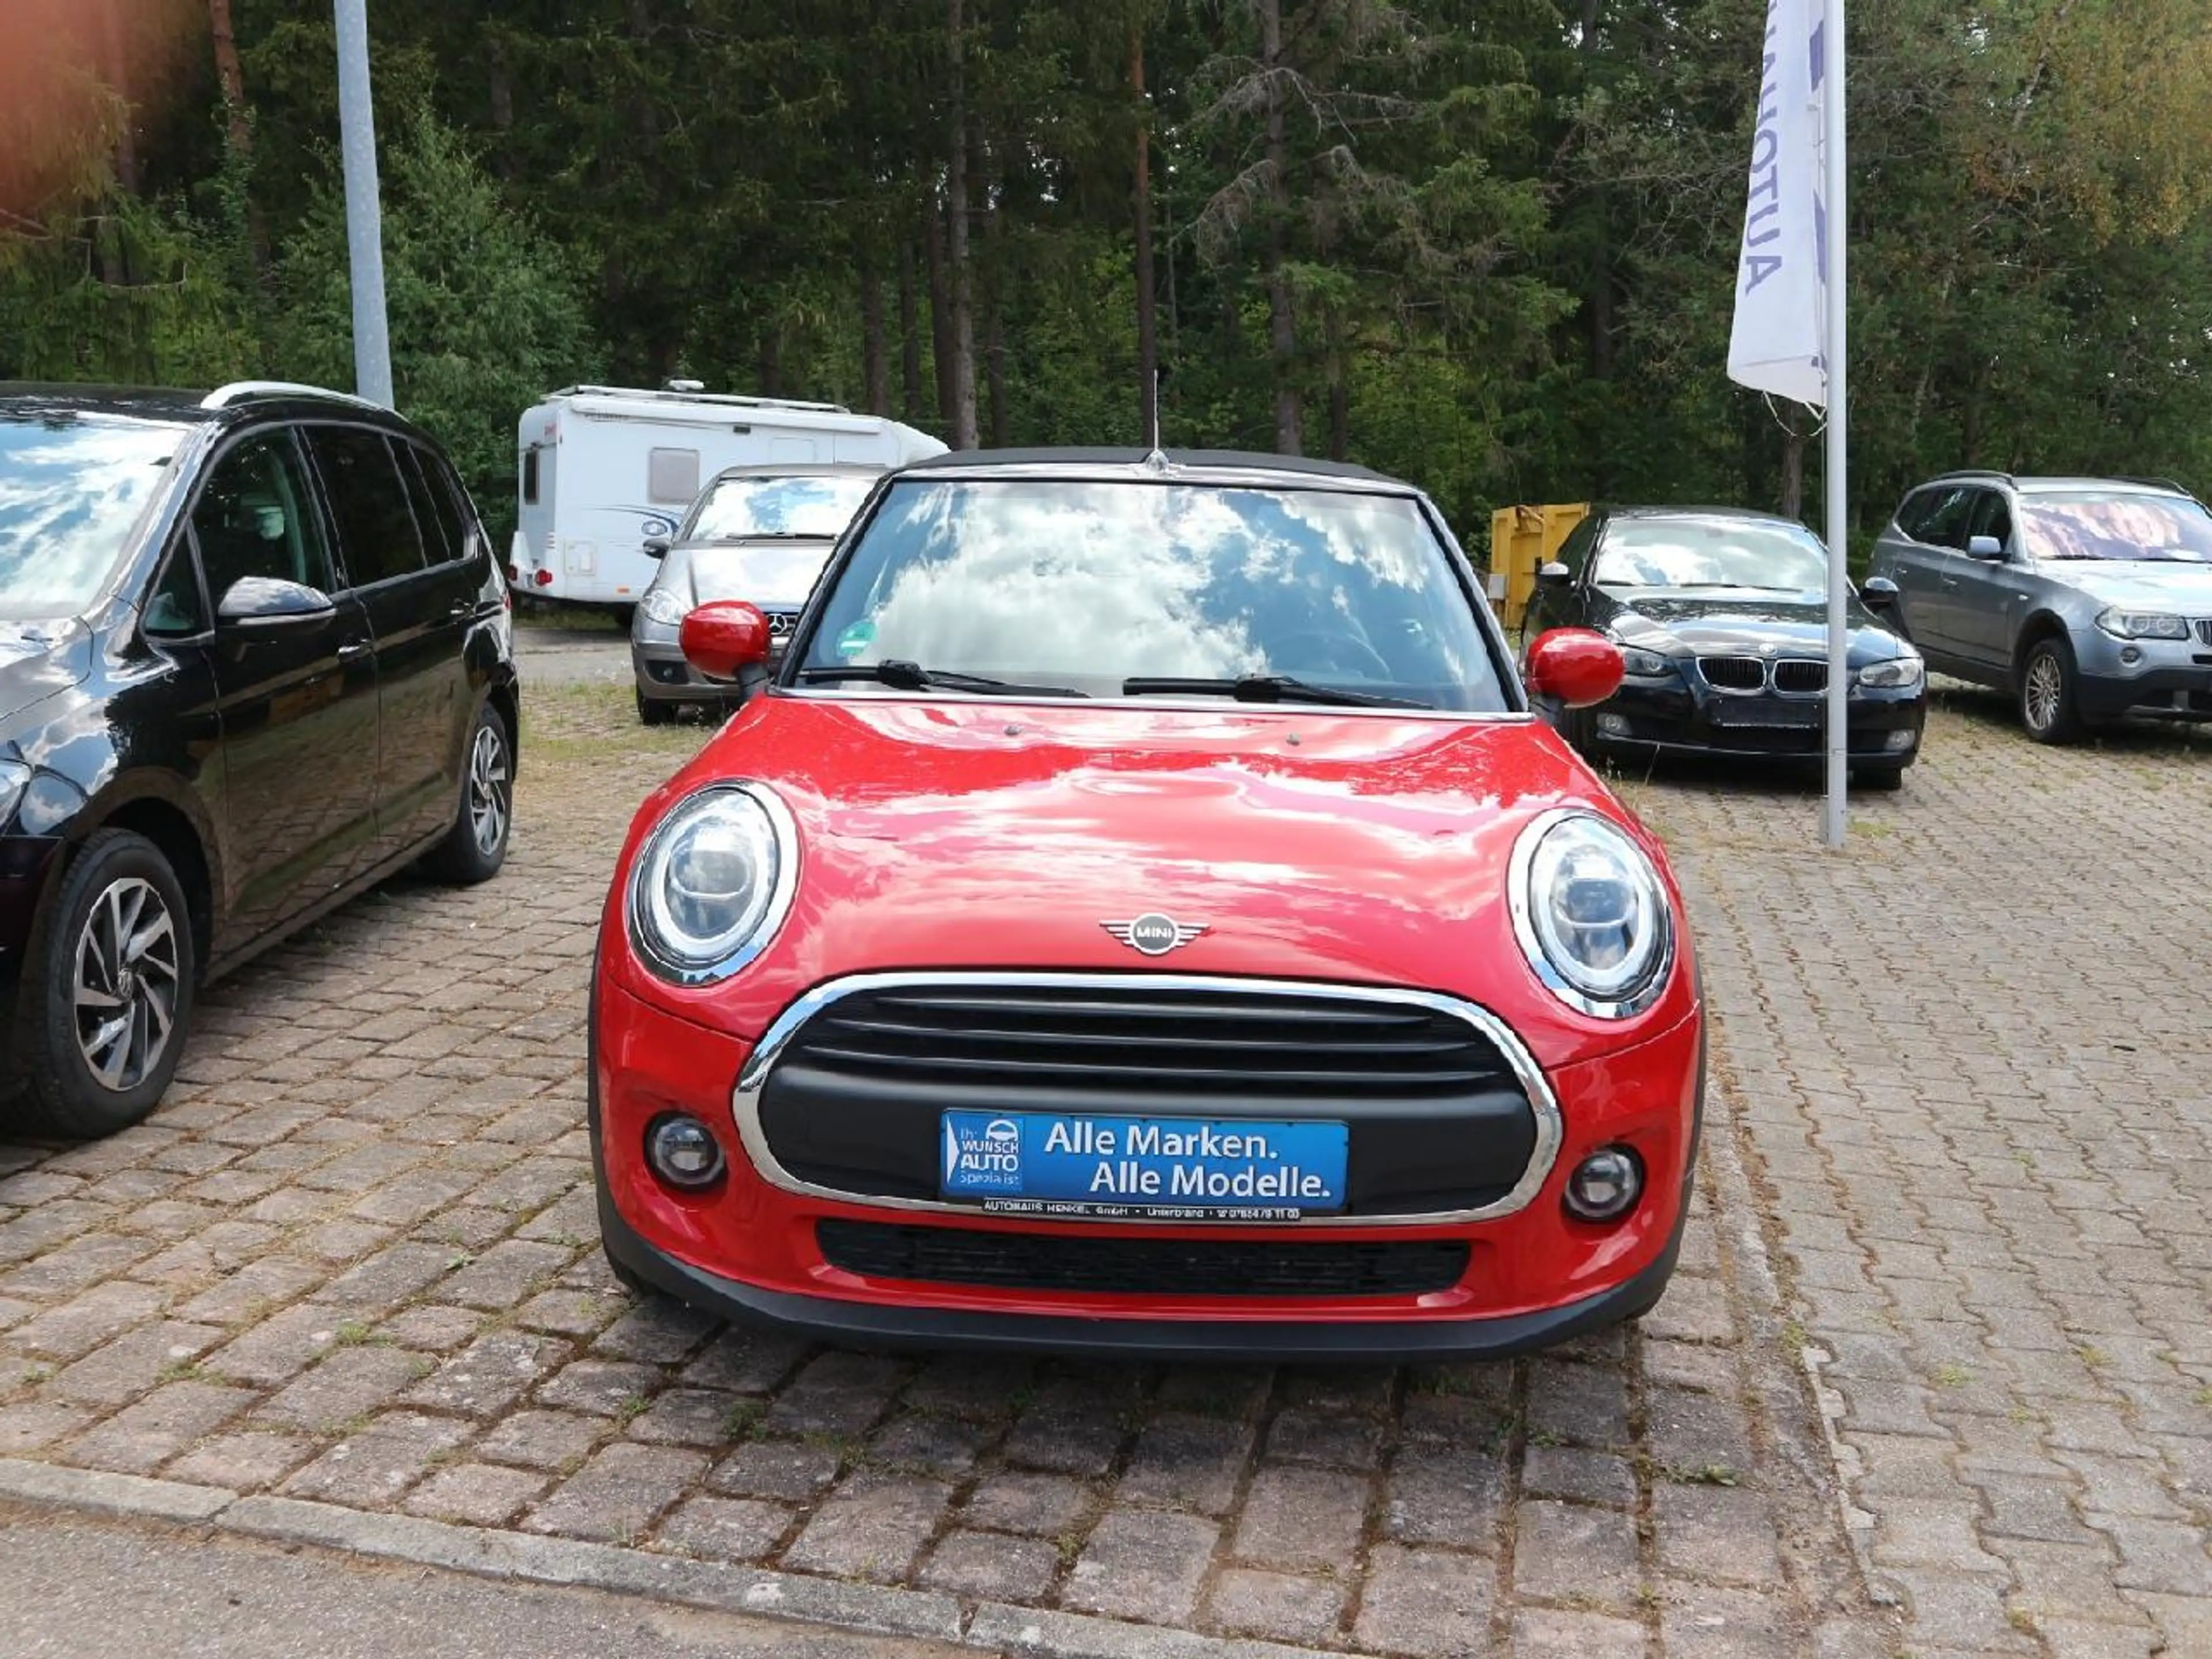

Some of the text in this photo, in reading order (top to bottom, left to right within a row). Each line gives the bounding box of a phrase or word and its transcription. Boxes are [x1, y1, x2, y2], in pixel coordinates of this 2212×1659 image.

[1137, 926, 1172, 938] MINI
[962, 1140, 1019, 1153] WUNSCH
[1044, 1121, 1278, 1158] Alle Marken.
[960, 1154, 1019, 1172] AUTO
[1089, 1161, 1331, 1196] Alle Modelle.
[984, 1201, 1043, 1211] AUTOHAUS
